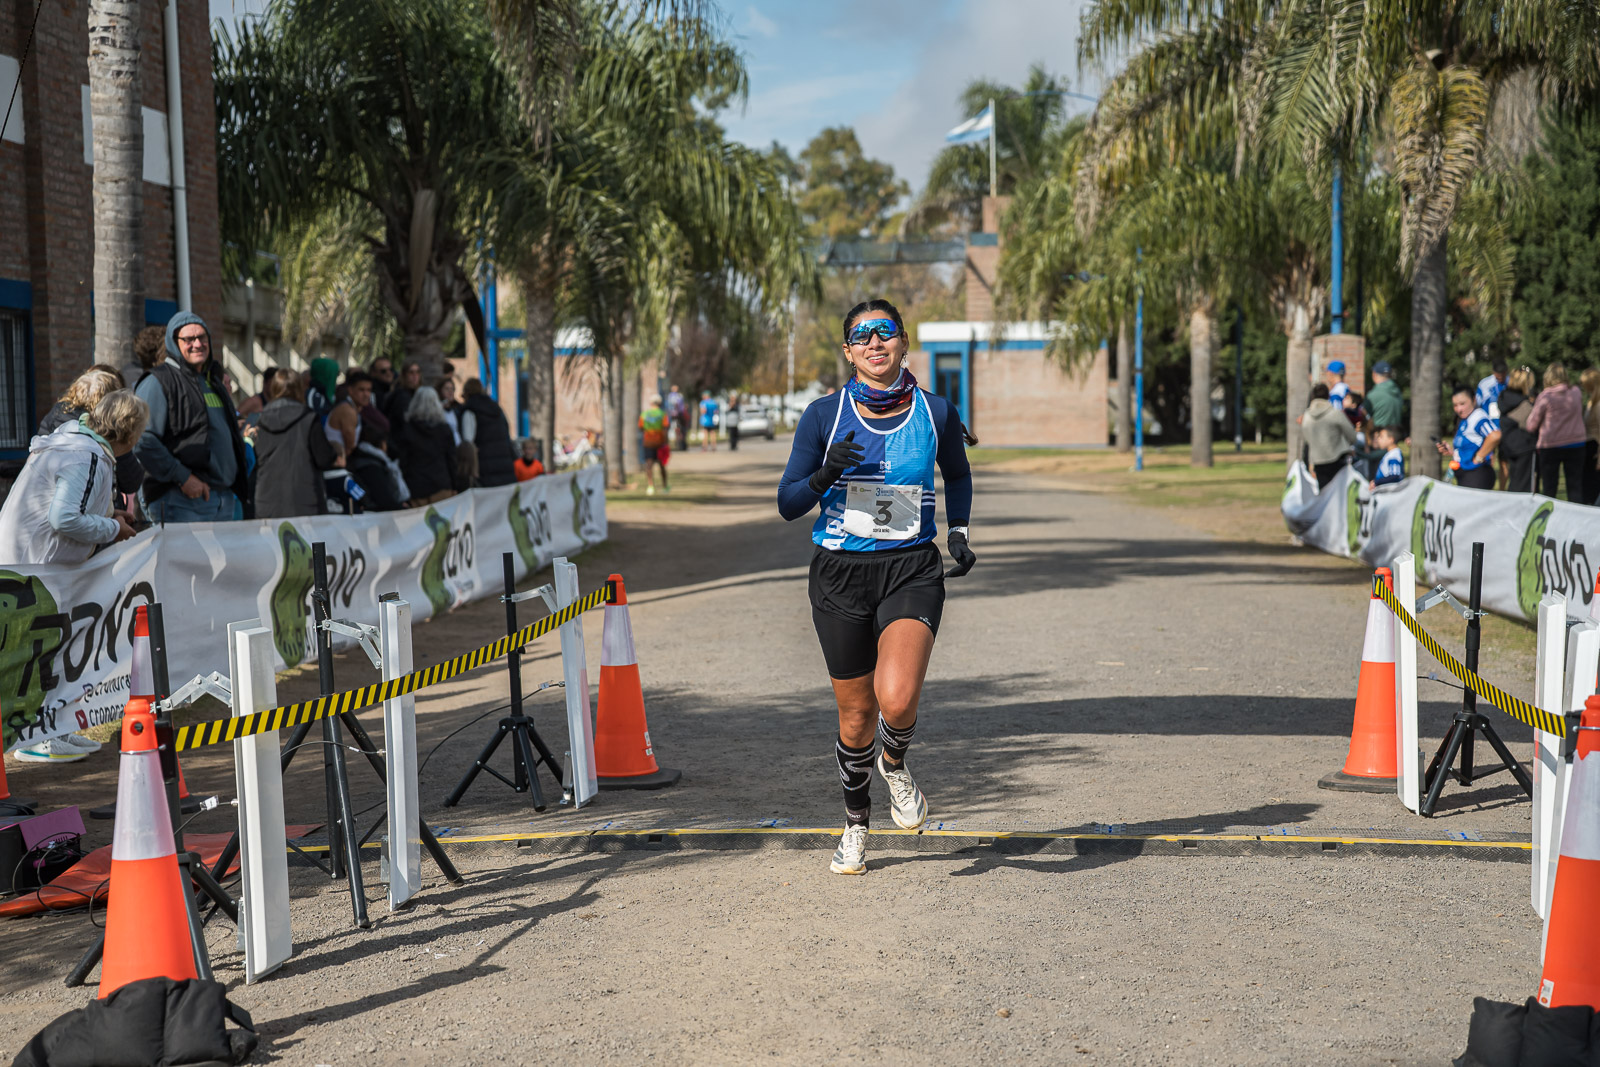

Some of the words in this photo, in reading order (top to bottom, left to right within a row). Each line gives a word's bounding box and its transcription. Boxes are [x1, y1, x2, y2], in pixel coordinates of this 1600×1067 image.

[873, 500, 893, 526] 3
[83, 673, 131, 703] @cronora
[89, 703, 125, 727] cronora
